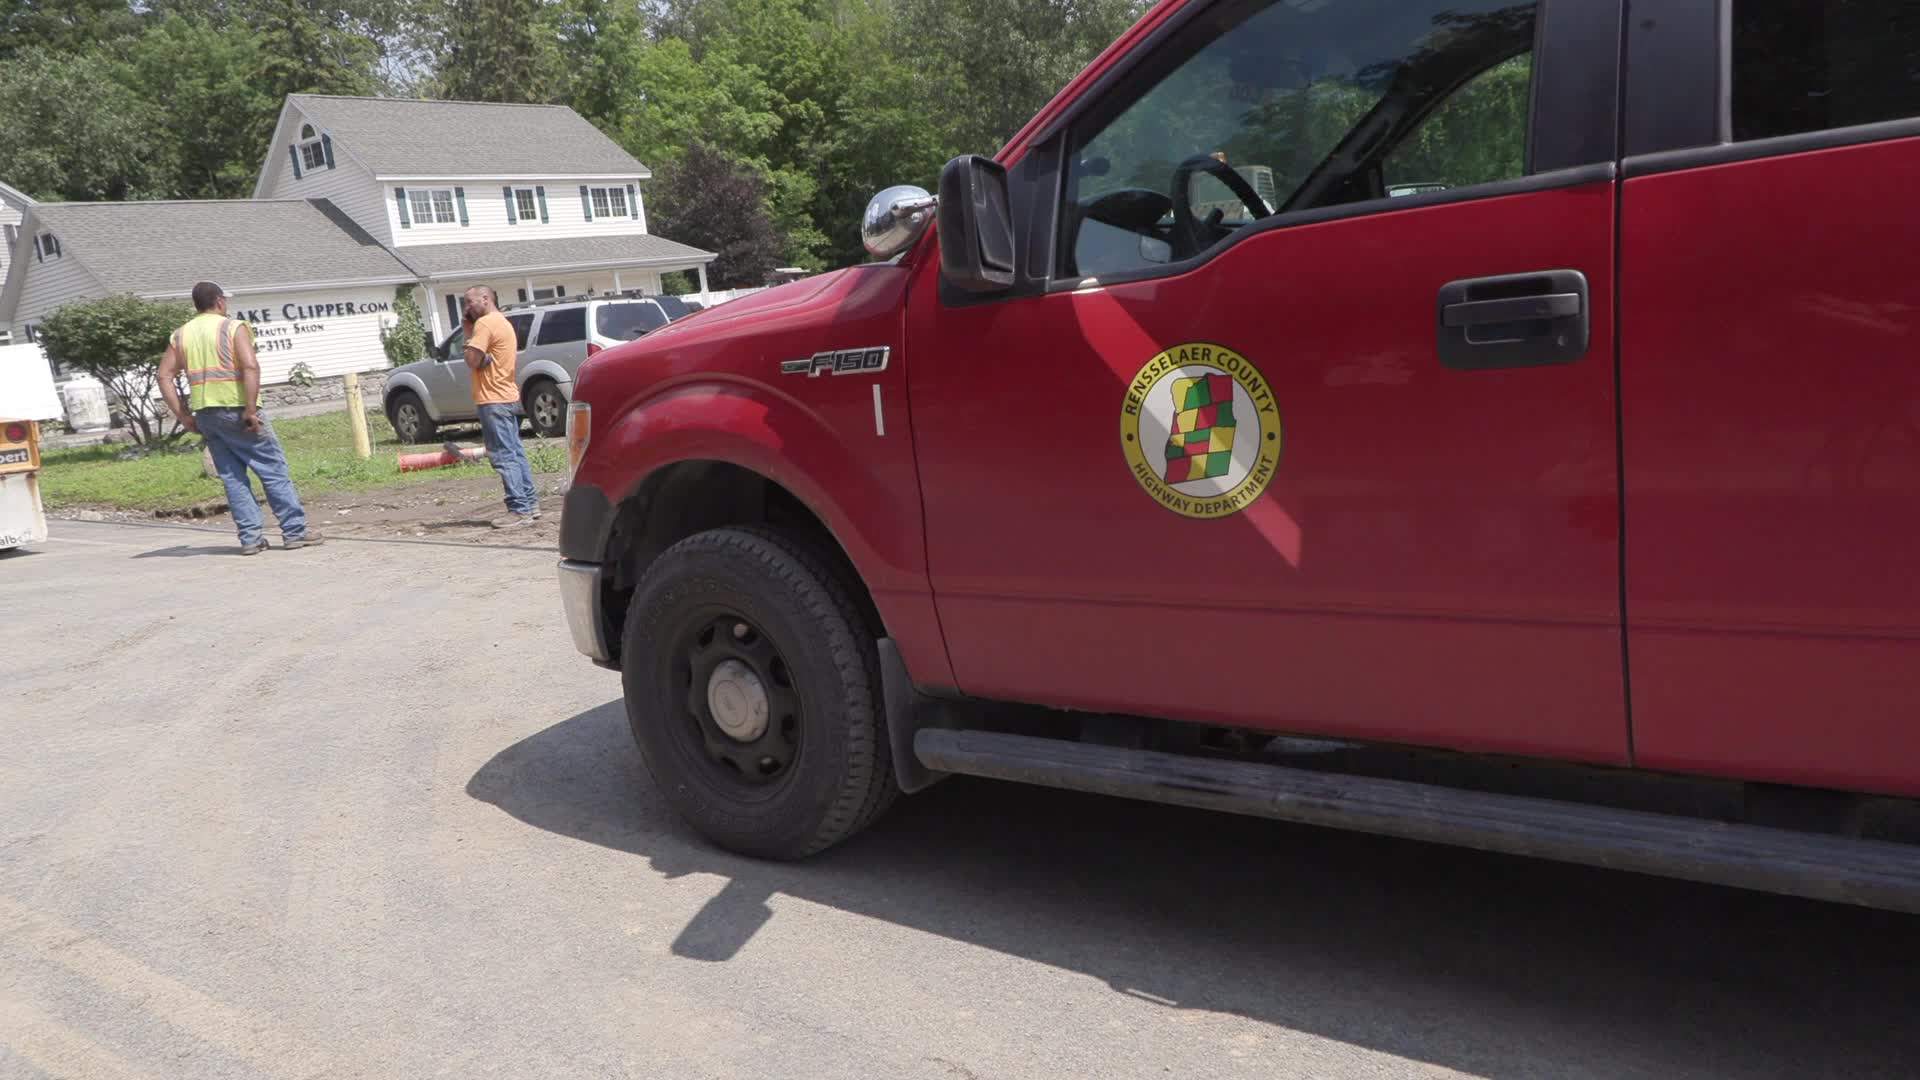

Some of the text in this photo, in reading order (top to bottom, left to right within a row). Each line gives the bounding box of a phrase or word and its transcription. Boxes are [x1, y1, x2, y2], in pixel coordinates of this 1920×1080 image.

[236, 302, 389, 324] AKE CLIPPER.COM
[294, 323, 324, 334] SALON
[1126, 347, 1274, 416] RENSSELAER COUNTY
[1134, 455, 1273, 514] HIGHWAY DEPARTMENT
